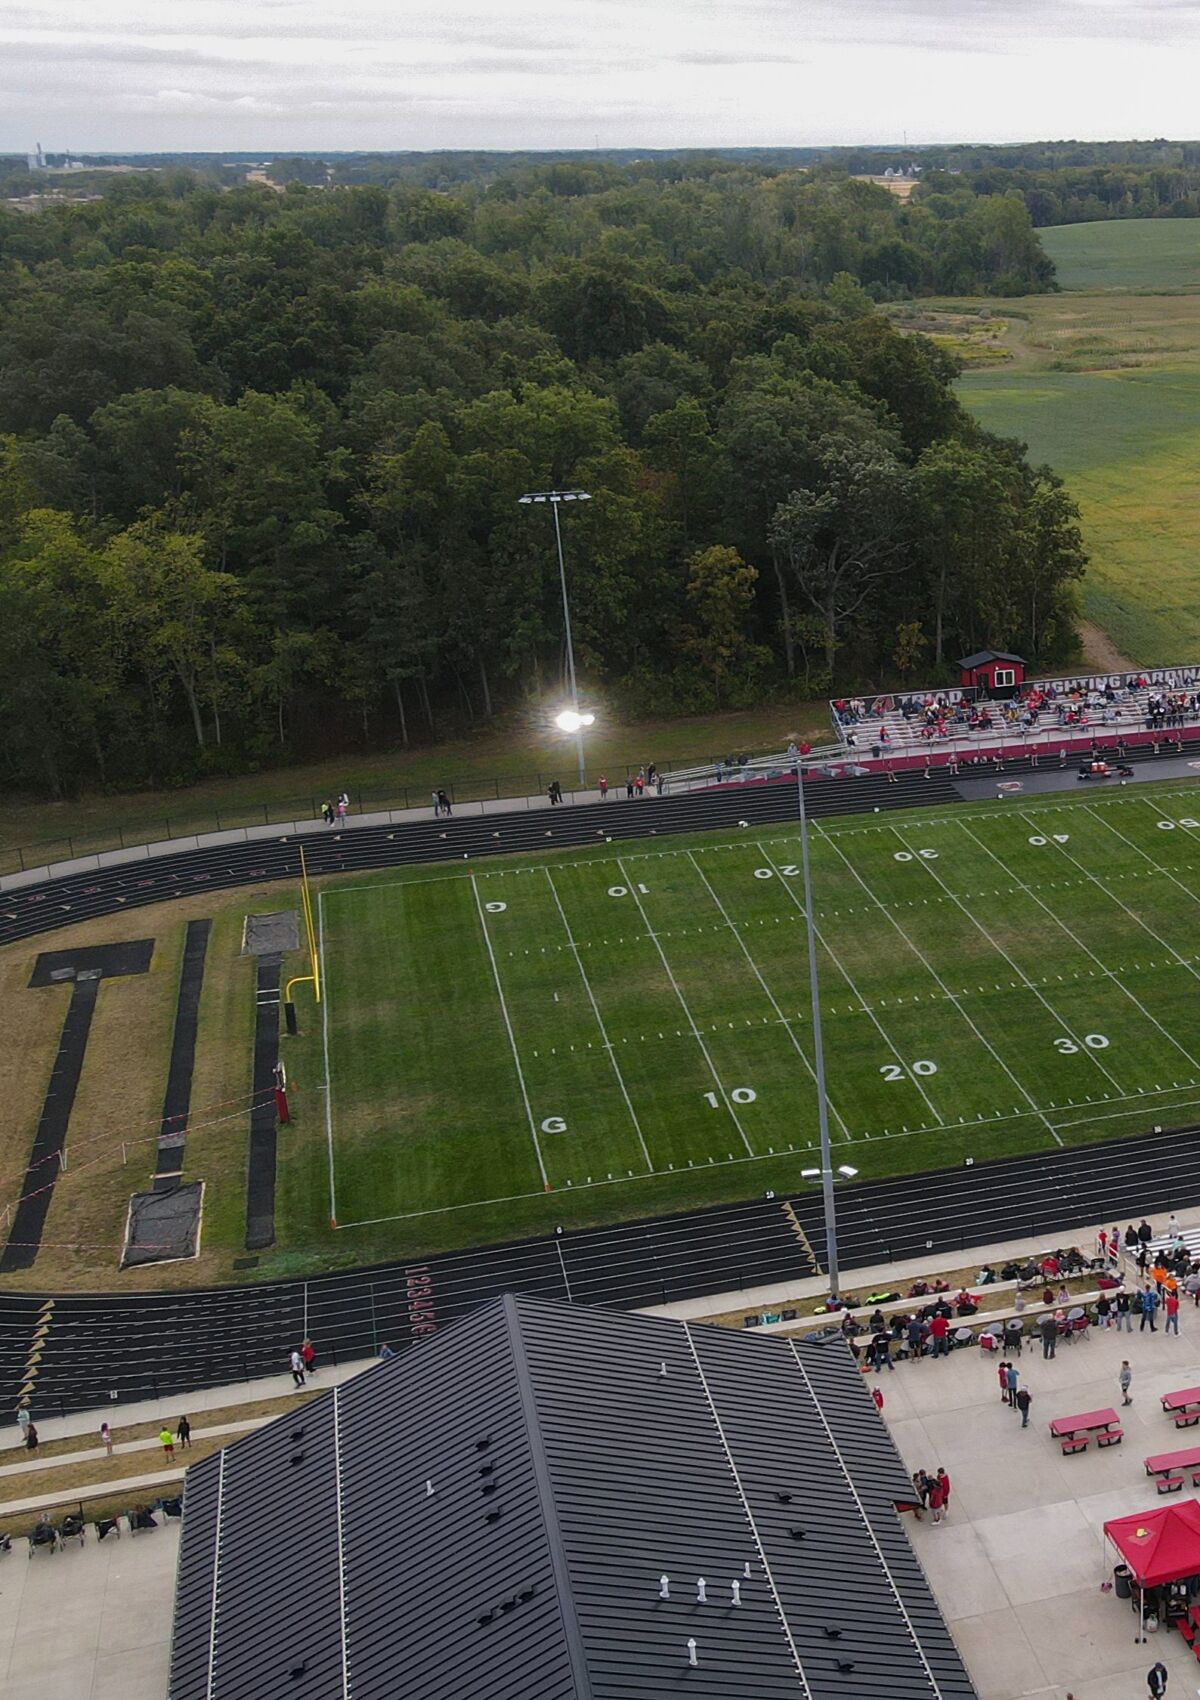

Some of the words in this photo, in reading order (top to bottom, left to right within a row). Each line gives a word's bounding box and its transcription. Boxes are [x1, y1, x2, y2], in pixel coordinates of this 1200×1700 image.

[1033, 675, 1121, 694] FIGHTING
[898, 690, 963, 706] TRIAD
[1156, 818, 1200, 830] 50
[1028, 833, 1070, 846] 40
[893, 848, 939, 862] 30
[753, 864, 800, 880] 20
[607, 883, 651, 897] 10
[485, 901, 508, 913] G
[1053, 1034, 1110, 1055] 30
[879, 1059, 938, 1082] 20
[703, 1087, 757, 1109] 10
[541, 1117, 567, 1134] G
